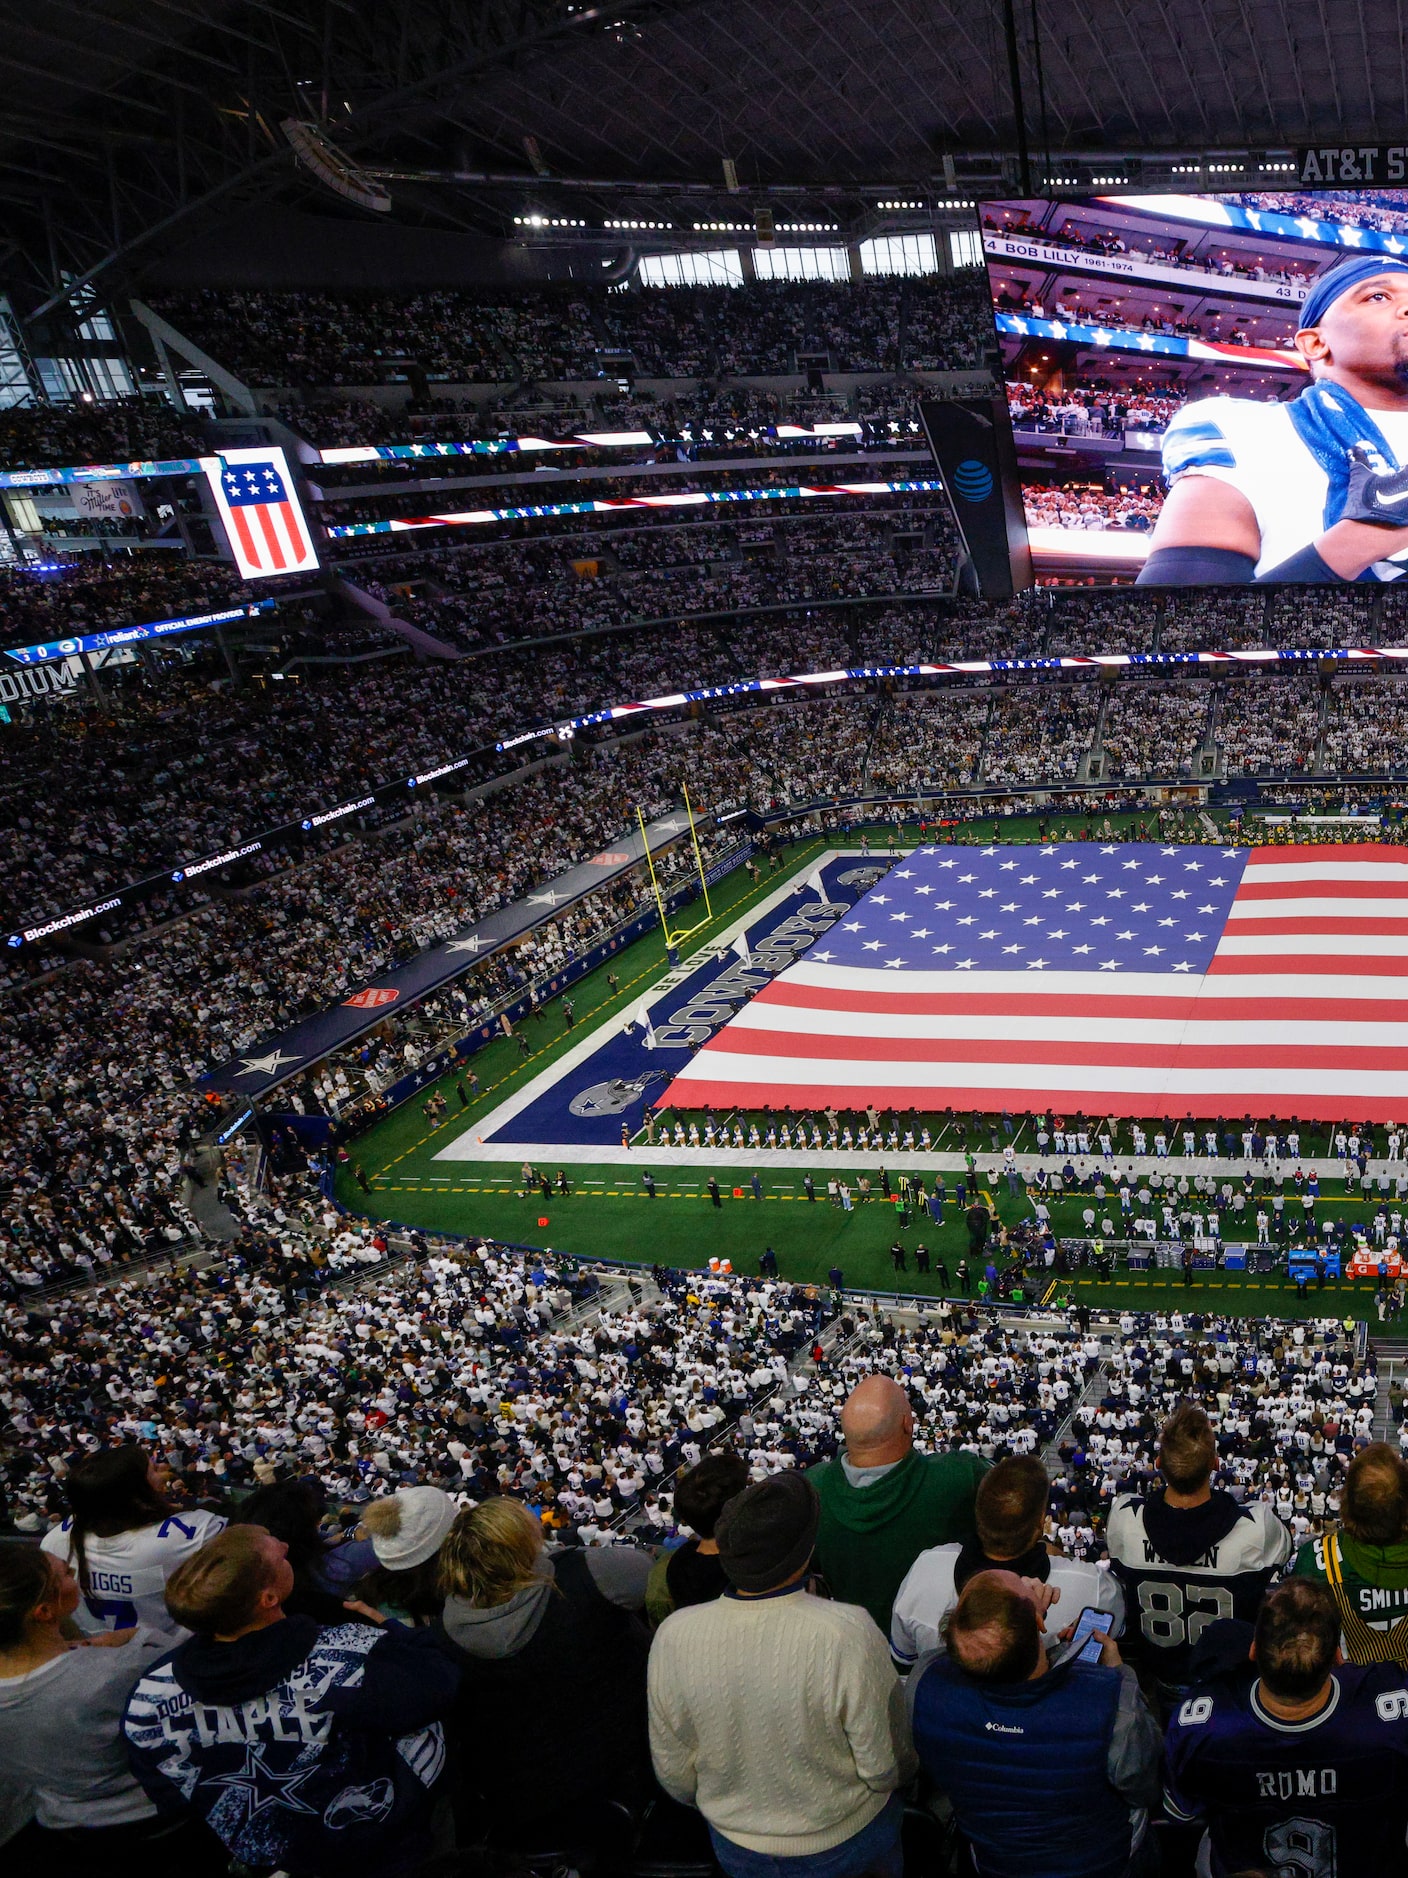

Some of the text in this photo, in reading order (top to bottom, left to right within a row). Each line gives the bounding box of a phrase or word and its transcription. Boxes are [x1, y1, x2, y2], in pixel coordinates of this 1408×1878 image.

[1300, 147, 1379, 182] AT&T
[1005, 243, 1038, 257] BOB
[1043, 249, 1080, 264] LILLY
[1084, 257, 1134, 272] 1961-1974
[1276, 287, 1291, 297] 43
[154, 608, 245, 633] OFFICIAL ENERGY PROVIDER
[108, 629, 141, 644] reliant
[37, 646, 48, 658] 0
[416, 758, 469, 785] Blockchain.com
[311, 796, 375, 827] Blockchain.com
[184, 840, 262, 878] Blockchain.com
[23, 897, 121, 942] Blockchain.com
[641, 902, 852, 1048] COWBOYS
[652, 944, 722, 992] BE LOVE
[1357, 1266, 1368, 1274] G
[1244, 1363, 1255, 1371] 12
[1262, 1364, 1268, 1372] 4
[1082, 1414, 1090, 1422] 11
[686, 1451, 693, 1460] 9
[1073, 1547, 1088, 1557] 88
[91, 1571, 133, 1594] IGGS
[1137, 1580, 1234, 1648] 82
[157, 1690, 335, 1765] STAPLE
[992, 1722, 1024, 1734] Columbia
[1255, 1768, 1337, 1800] ROMO
